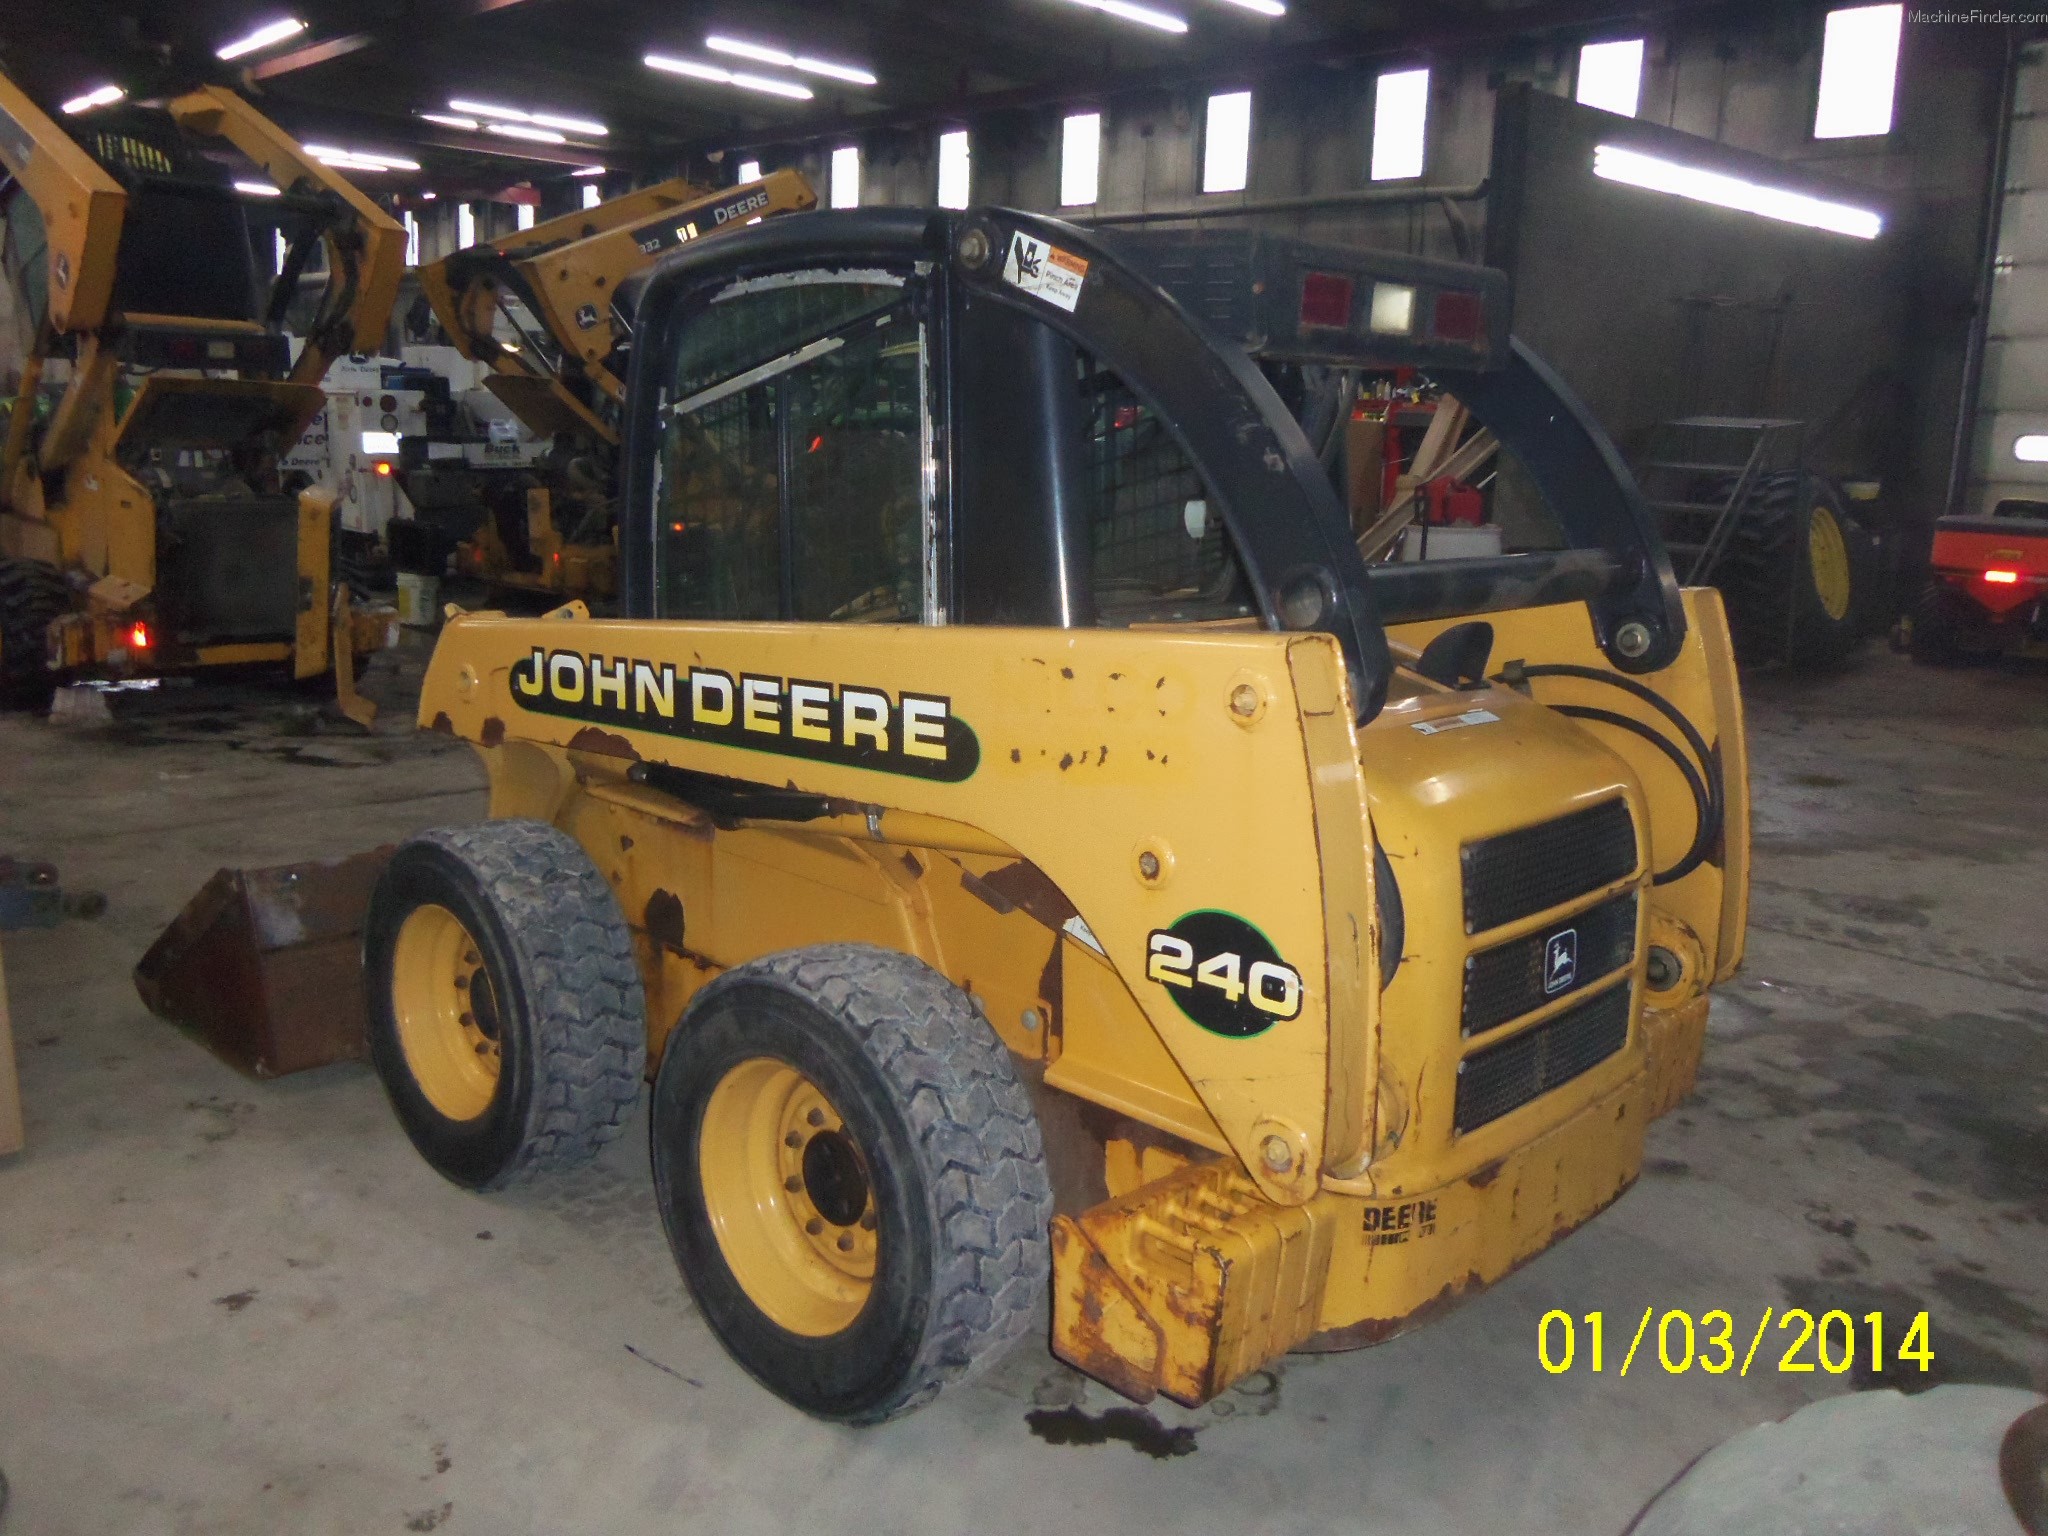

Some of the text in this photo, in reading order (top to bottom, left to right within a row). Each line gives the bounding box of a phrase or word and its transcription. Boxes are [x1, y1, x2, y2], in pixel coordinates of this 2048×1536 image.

[714, 192, 768, 225] DEERE
[517, 648, 949, 762] JOHN DEERE
[1148, 931, 1302, 1019] 240
